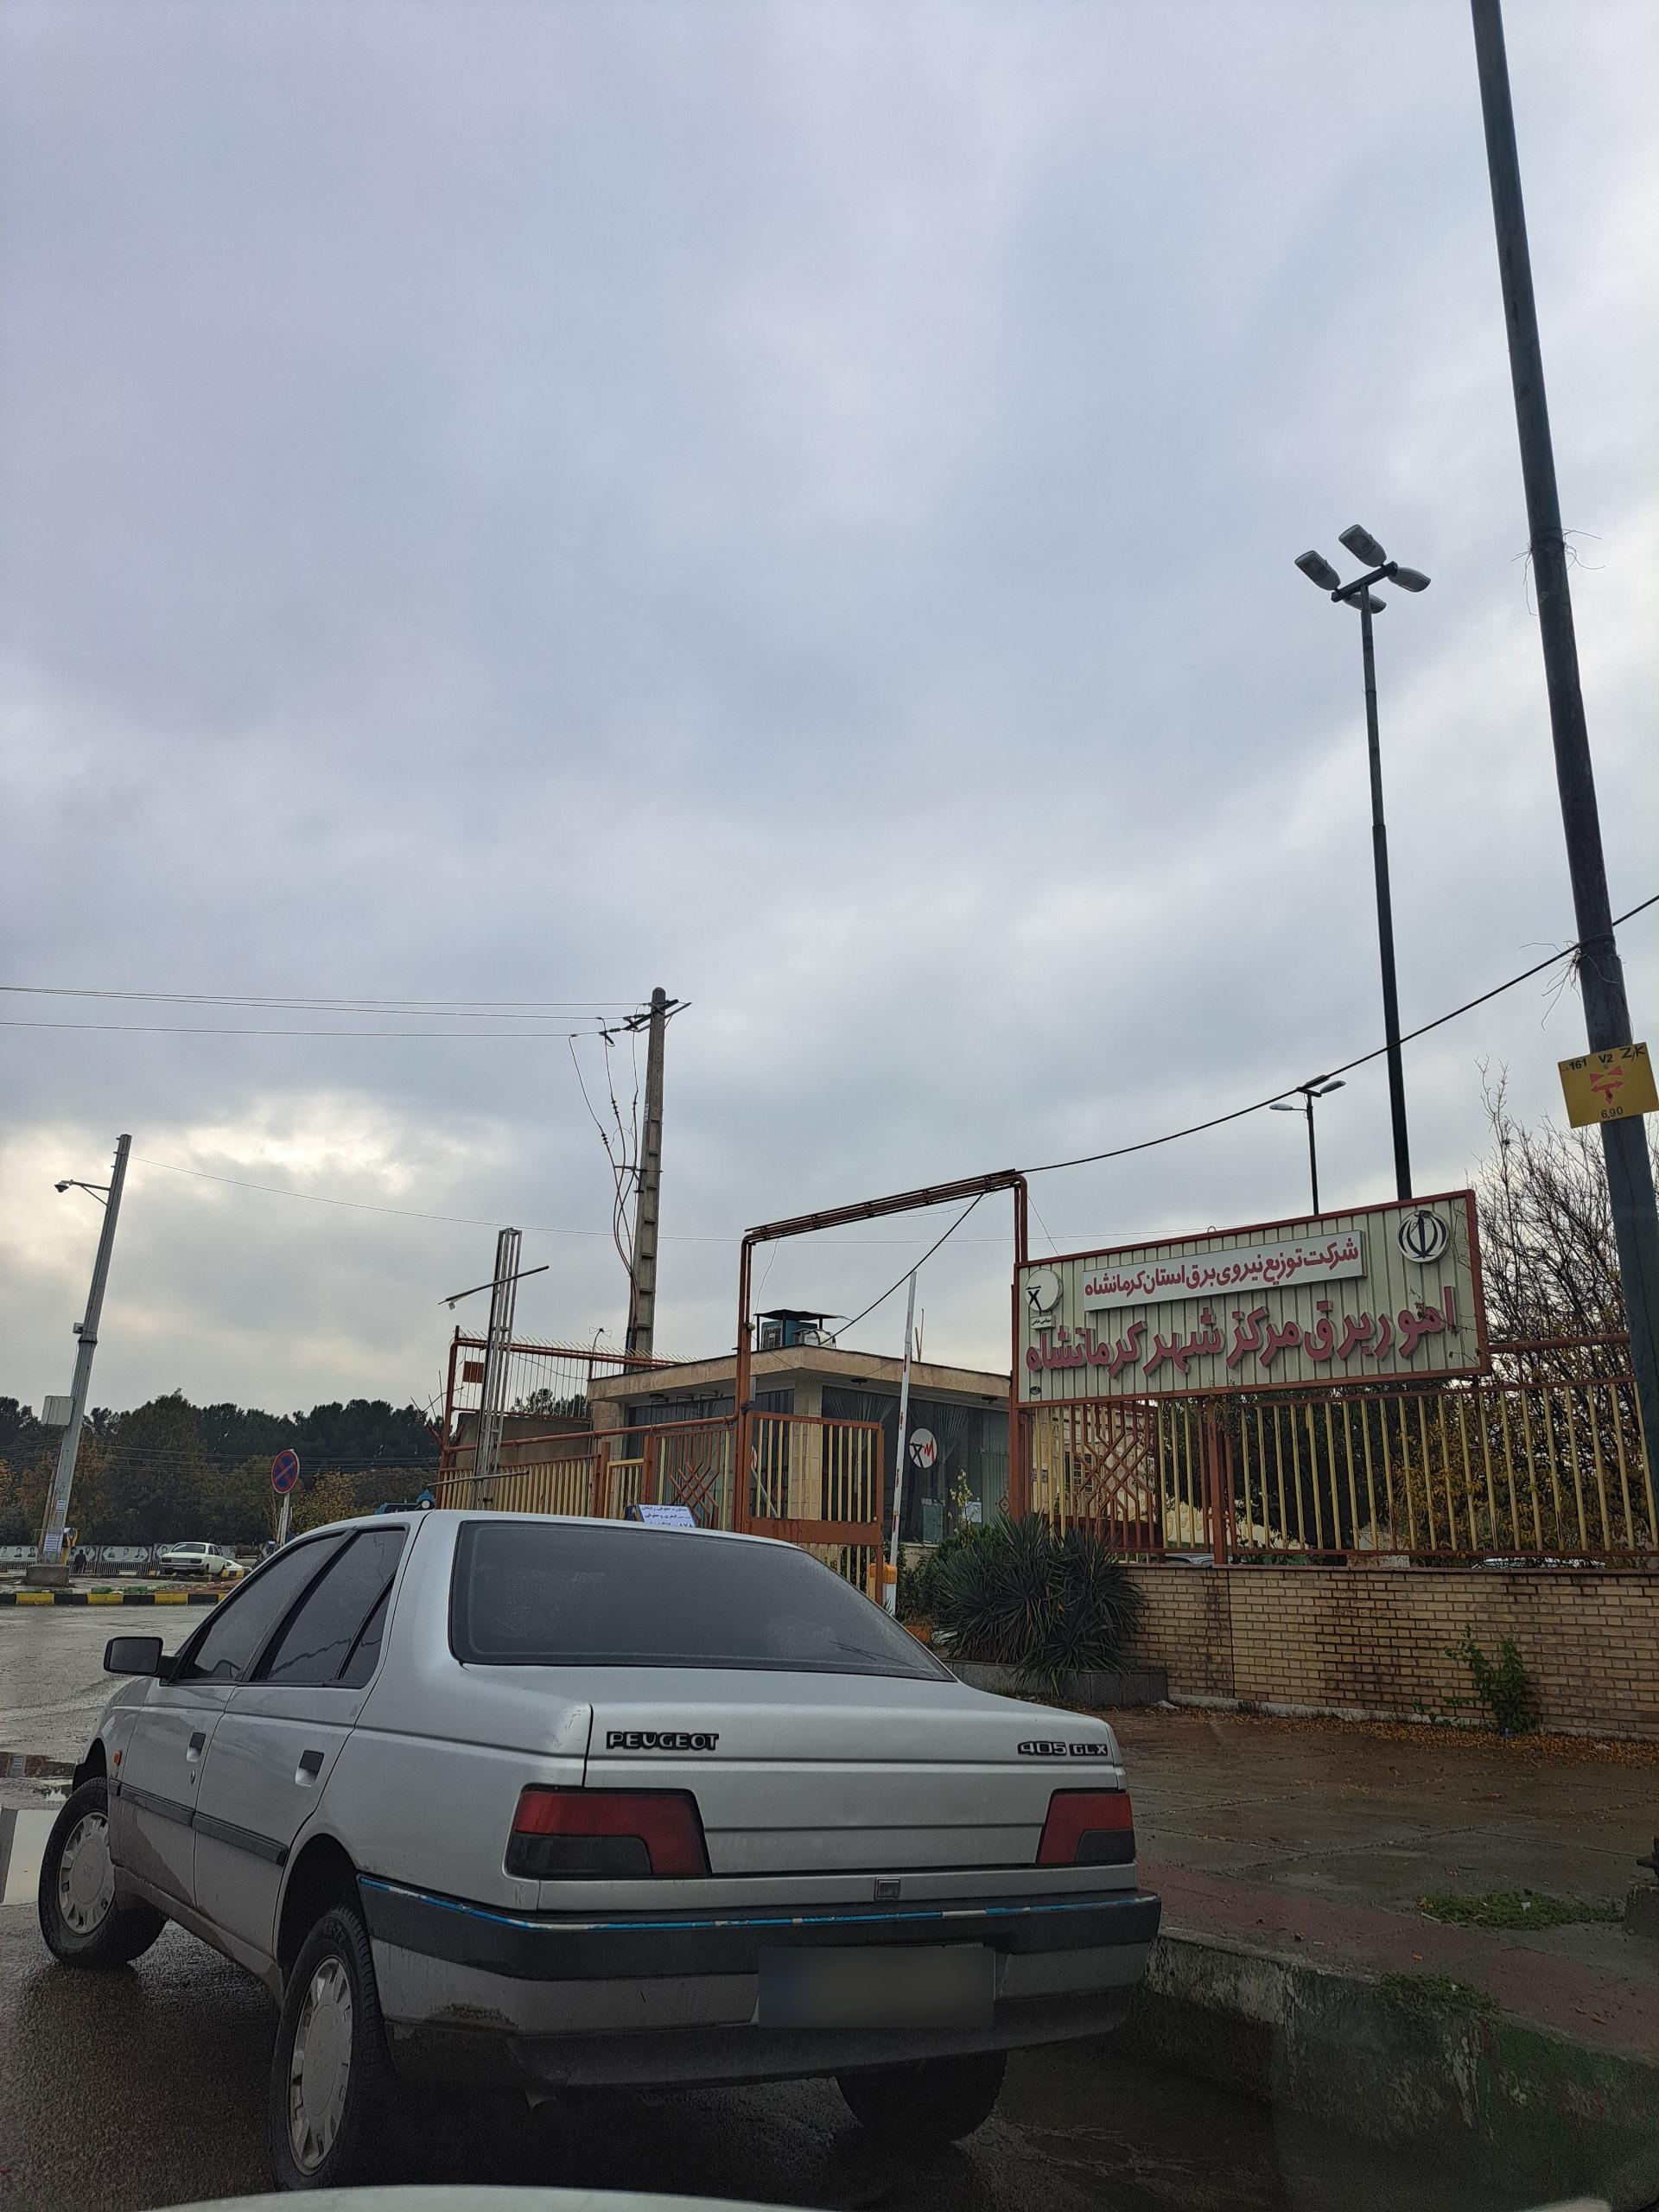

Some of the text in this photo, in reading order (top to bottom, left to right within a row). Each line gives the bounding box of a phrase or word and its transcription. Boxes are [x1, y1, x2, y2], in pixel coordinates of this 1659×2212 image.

[1599, 1054, 1613, 1064] V2
[1084, 1237, 1359, 1297] شرکت توزیع نیروی برق استان کرمانشاه
[1026, 1286, 1457, 1379] امور برق مرکز شهر کرمانشاه
[607, 1732, 719, 1750] PEUGEOT
[1018, 1741, 1109, 1756] 405 GLX
